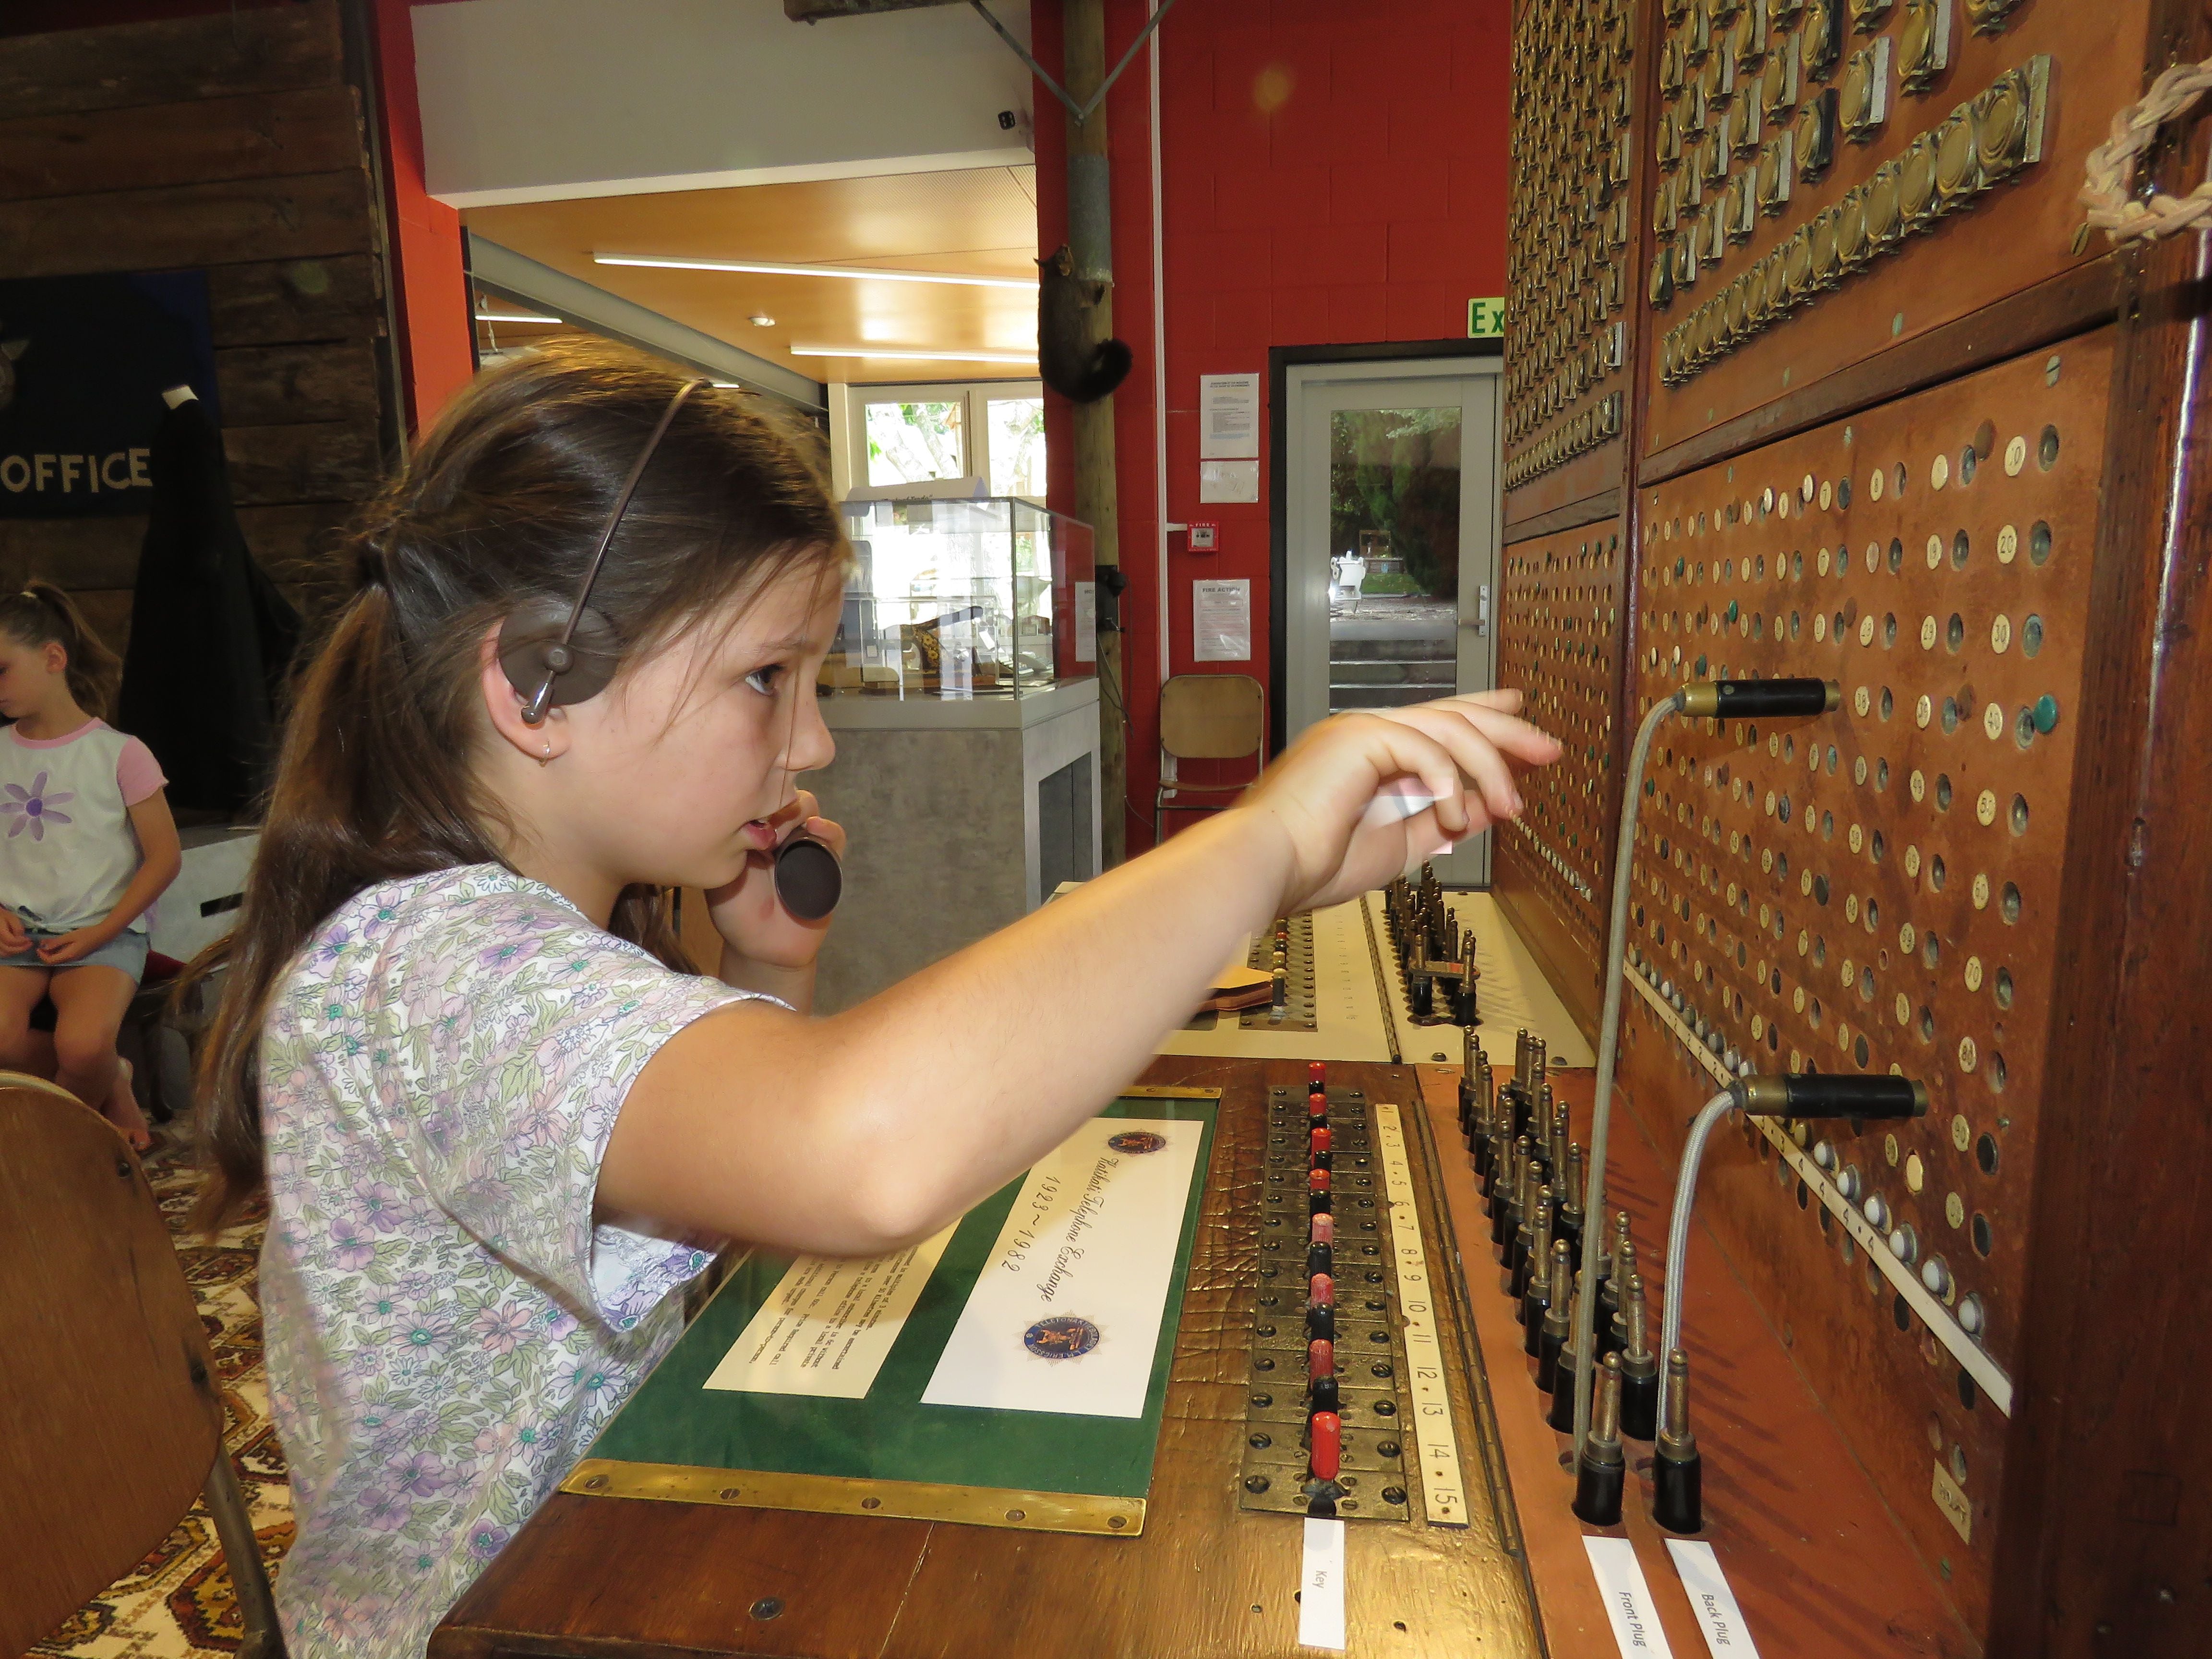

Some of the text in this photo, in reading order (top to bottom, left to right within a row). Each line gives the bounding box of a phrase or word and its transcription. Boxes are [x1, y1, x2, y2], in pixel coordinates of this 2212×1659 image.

[0, 447, 153, 493] OFFICE
[1036, 1156, 1119, 1302] Katikati Telephone Exchange
[1407, 1300, 1427, 1313] 10
[814, 1331, 829, 1345] local
[1412, 1334, 1432, 1343] 11
[768, 1353, 783, 1365] call
[798, 1346, 819, 1368] private
[810, 1347, 830, 1368] without
[831, 1337, 856, 1369] ascertained
[1417, 1367, 1438, 1379] 12
[1421, 1402, 1444, 1416] 13
[1427, 1444, 1450, 1460] 14
[1433, 1488, 1458, 1504] 15
[1312, 1570, 1327, 1588] Key
[1619, 1591, 1647, 1648] Front Plug
[1701, 1594, 1731, 1647] Back Plug
